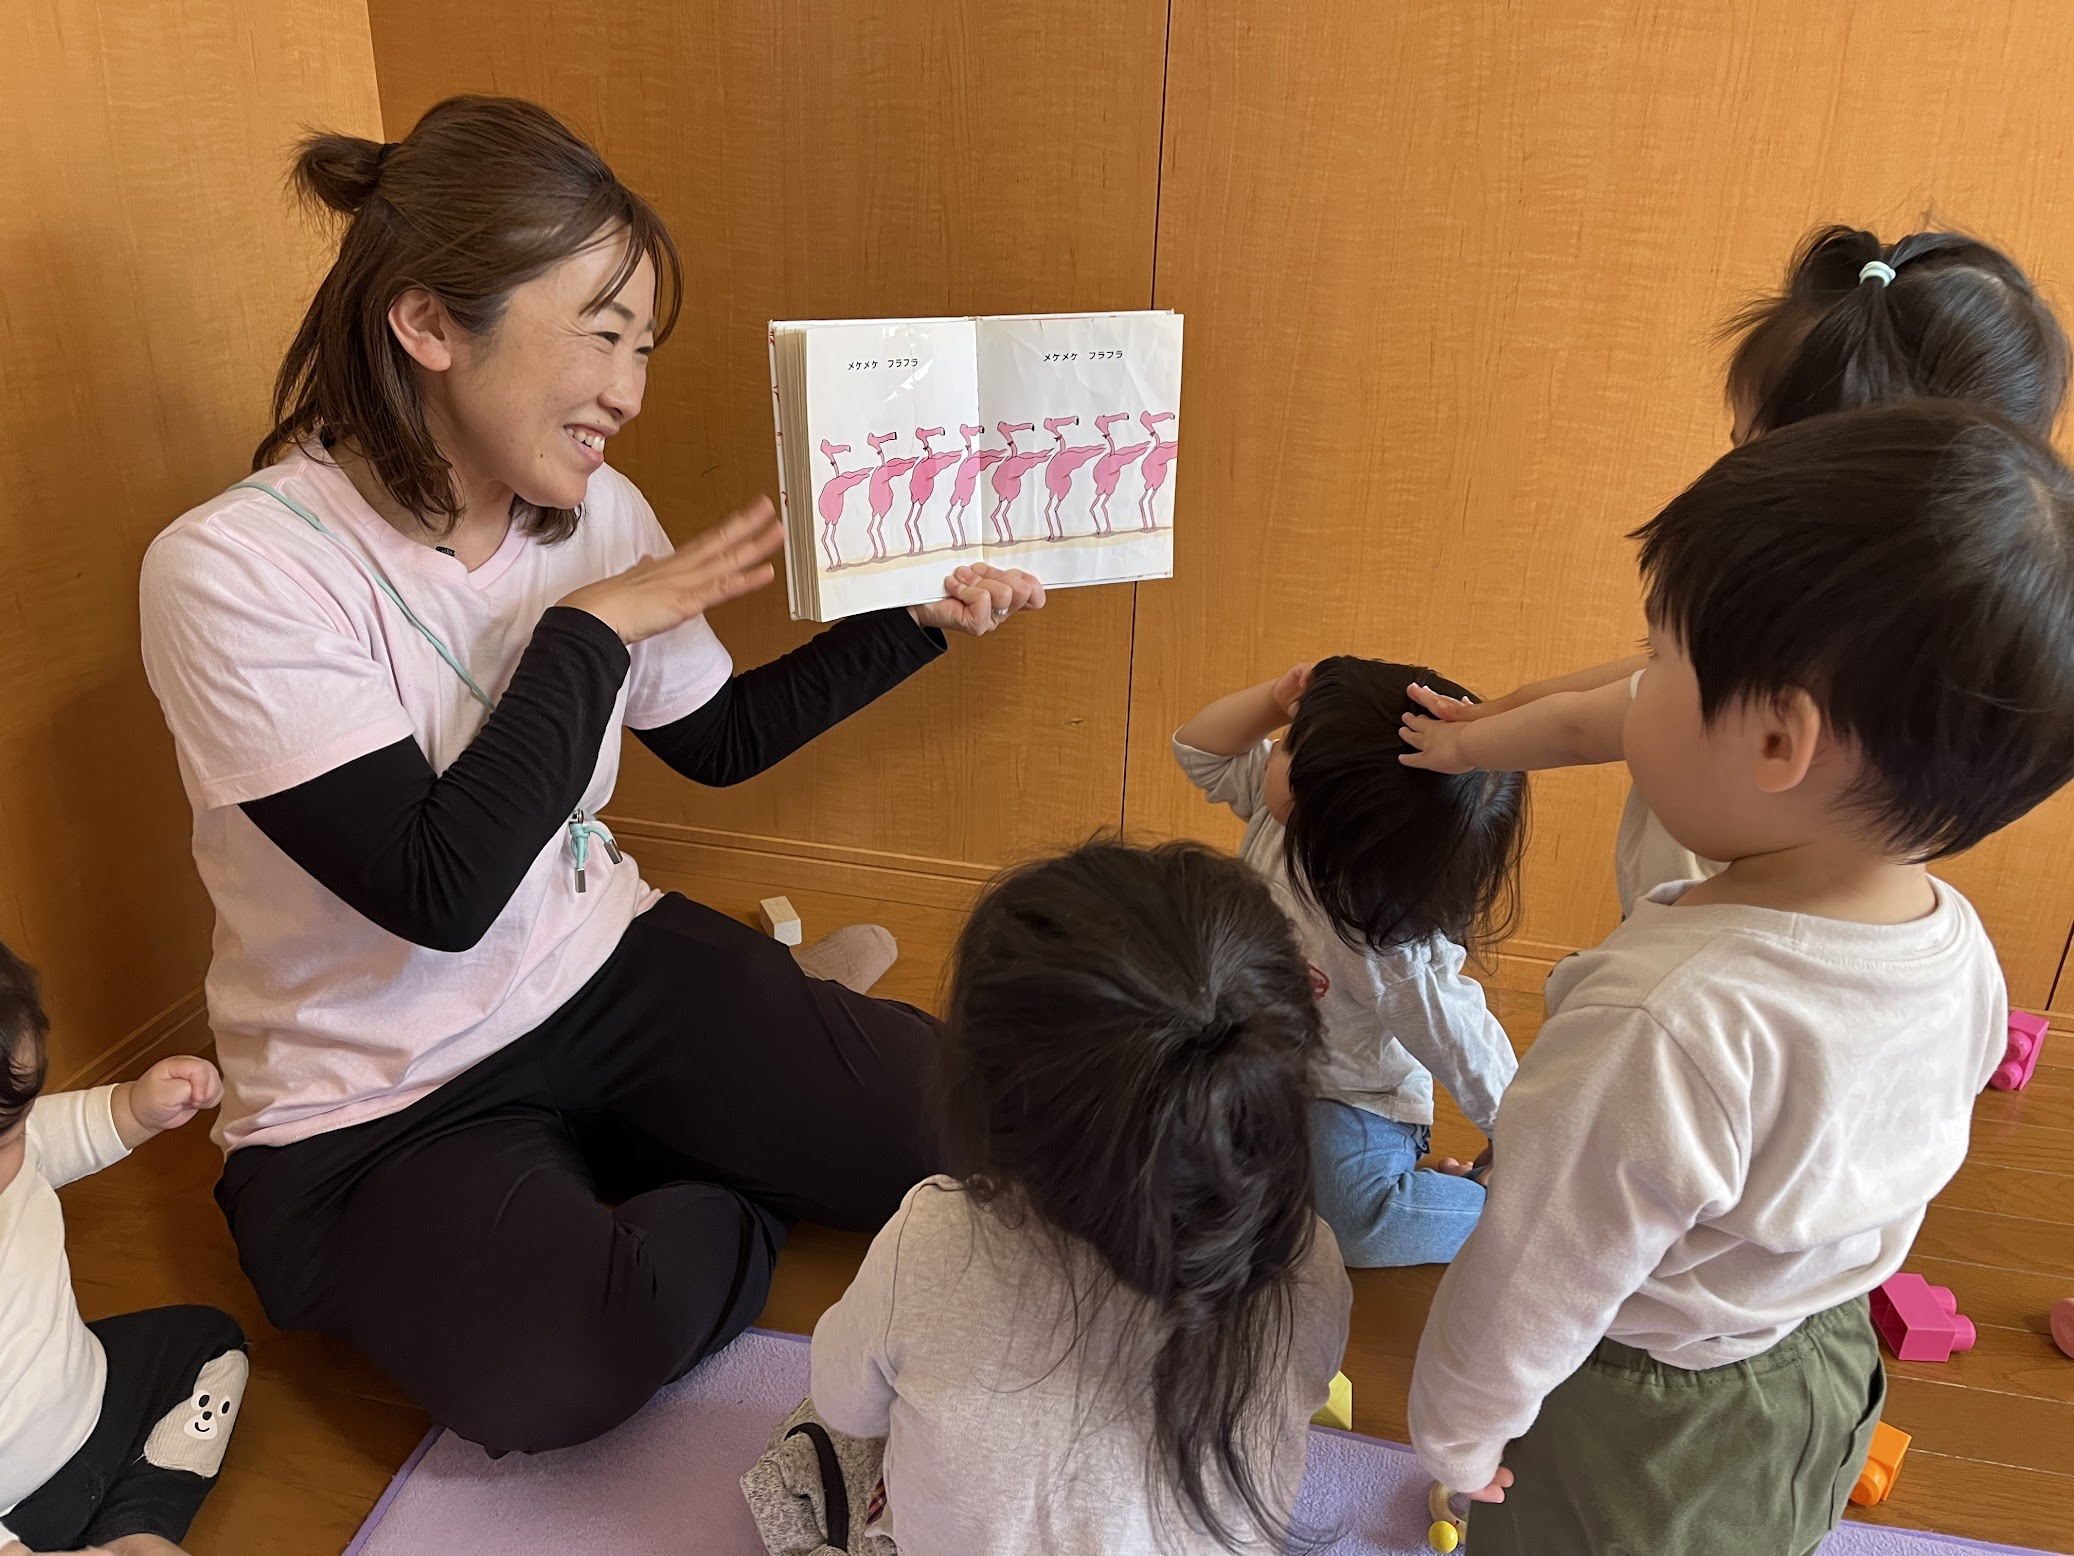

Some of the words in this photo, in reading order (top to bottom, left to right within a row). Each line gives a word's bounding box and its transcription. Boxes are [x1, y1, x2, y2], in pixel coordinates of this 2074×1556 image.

[1043, 352, 1078, 362] メケメケ
[1088, 350, 1123, 360] フラフラ
[847, 360, 879, 371] メケメケ
[887, 358, 919, 369] フラフラ
